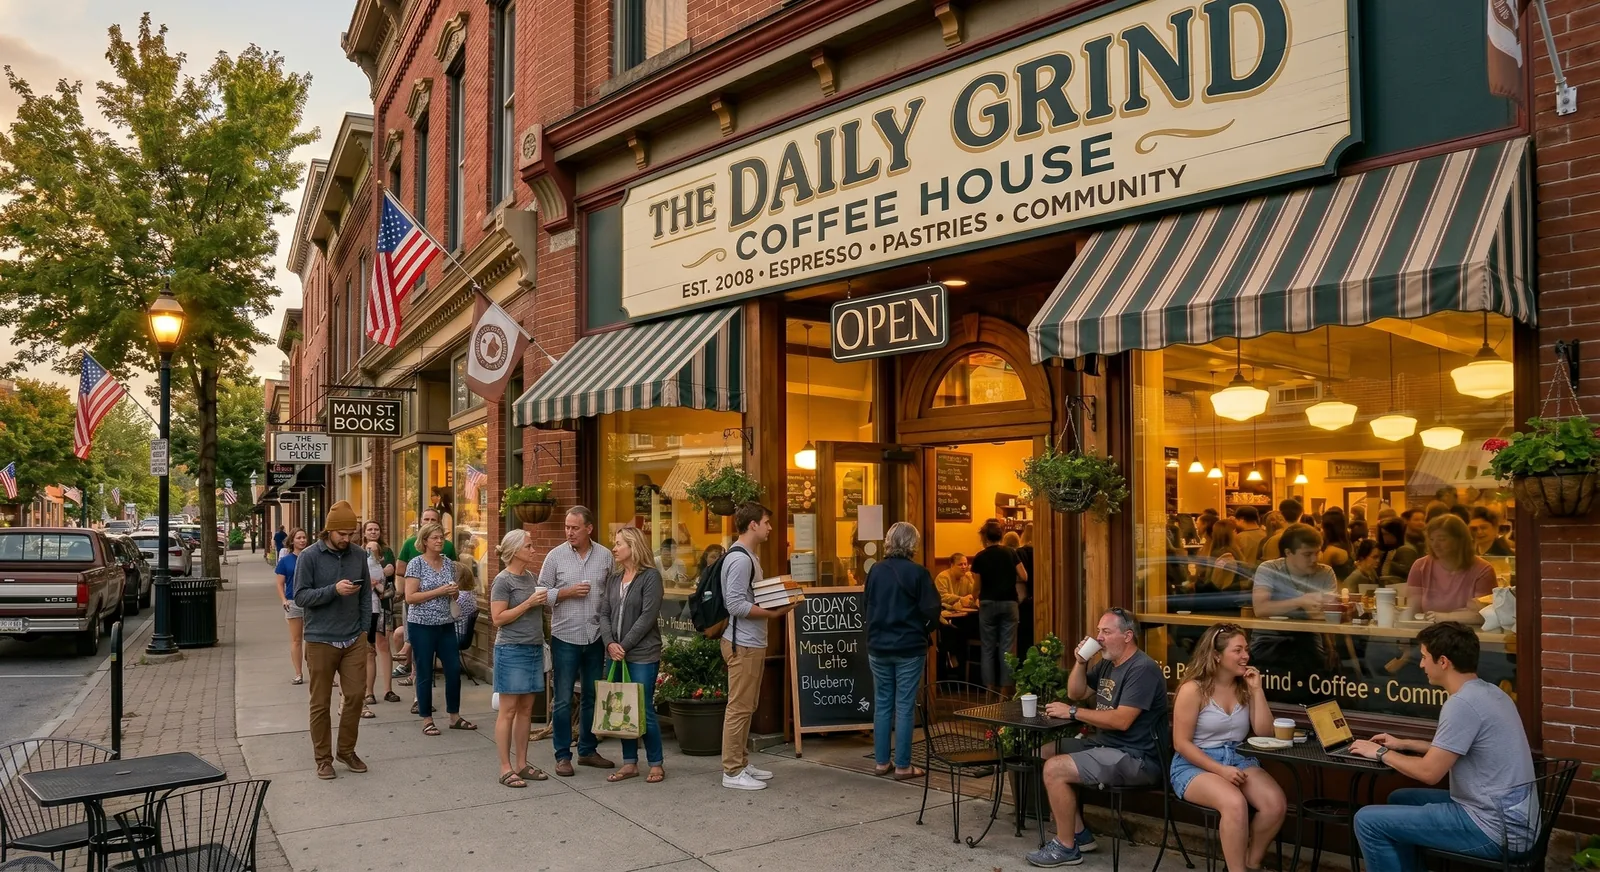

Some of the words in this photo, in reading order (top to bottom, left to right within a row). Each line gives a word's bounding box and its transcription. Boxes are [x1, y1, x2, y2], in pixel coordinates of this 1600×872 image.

[649, 182, 717, 241] THE
[728, 95, 925, 232] DAILY
[950, 0, 1293, 154] GRIND
[736, 190, 899, 261] COFFEE
[920, 131, 1115, 217] HOUSE
[682, 279, 711, 298] EST.
[716, 268, 754, 292] 2008
[769, 242, 862, 279] ESPRESSO
[882, 212, 988, 253] PASTRIES
[1013, 164, 1188, 223] COMMUNITY
[836, 293, 939, 351] OPEN
[334, 403, 372, 416] MAIN
[376, 405, 395, 416] ST.
[334, 417, 395, 431] BOOKS
[804, 596, 858, 614] TODAY'S
[802, 613, 862, 631] SPECIALS
[837, 639, 858, 653] Out
[818, 655, 848, 669] Lette
[801, 675, 855, 693] Blueberry
[1260, 669, 1291, 691] rind
[1308, 673, 1369, 699] Coffee
[813, 691, 853, 705] Scones
